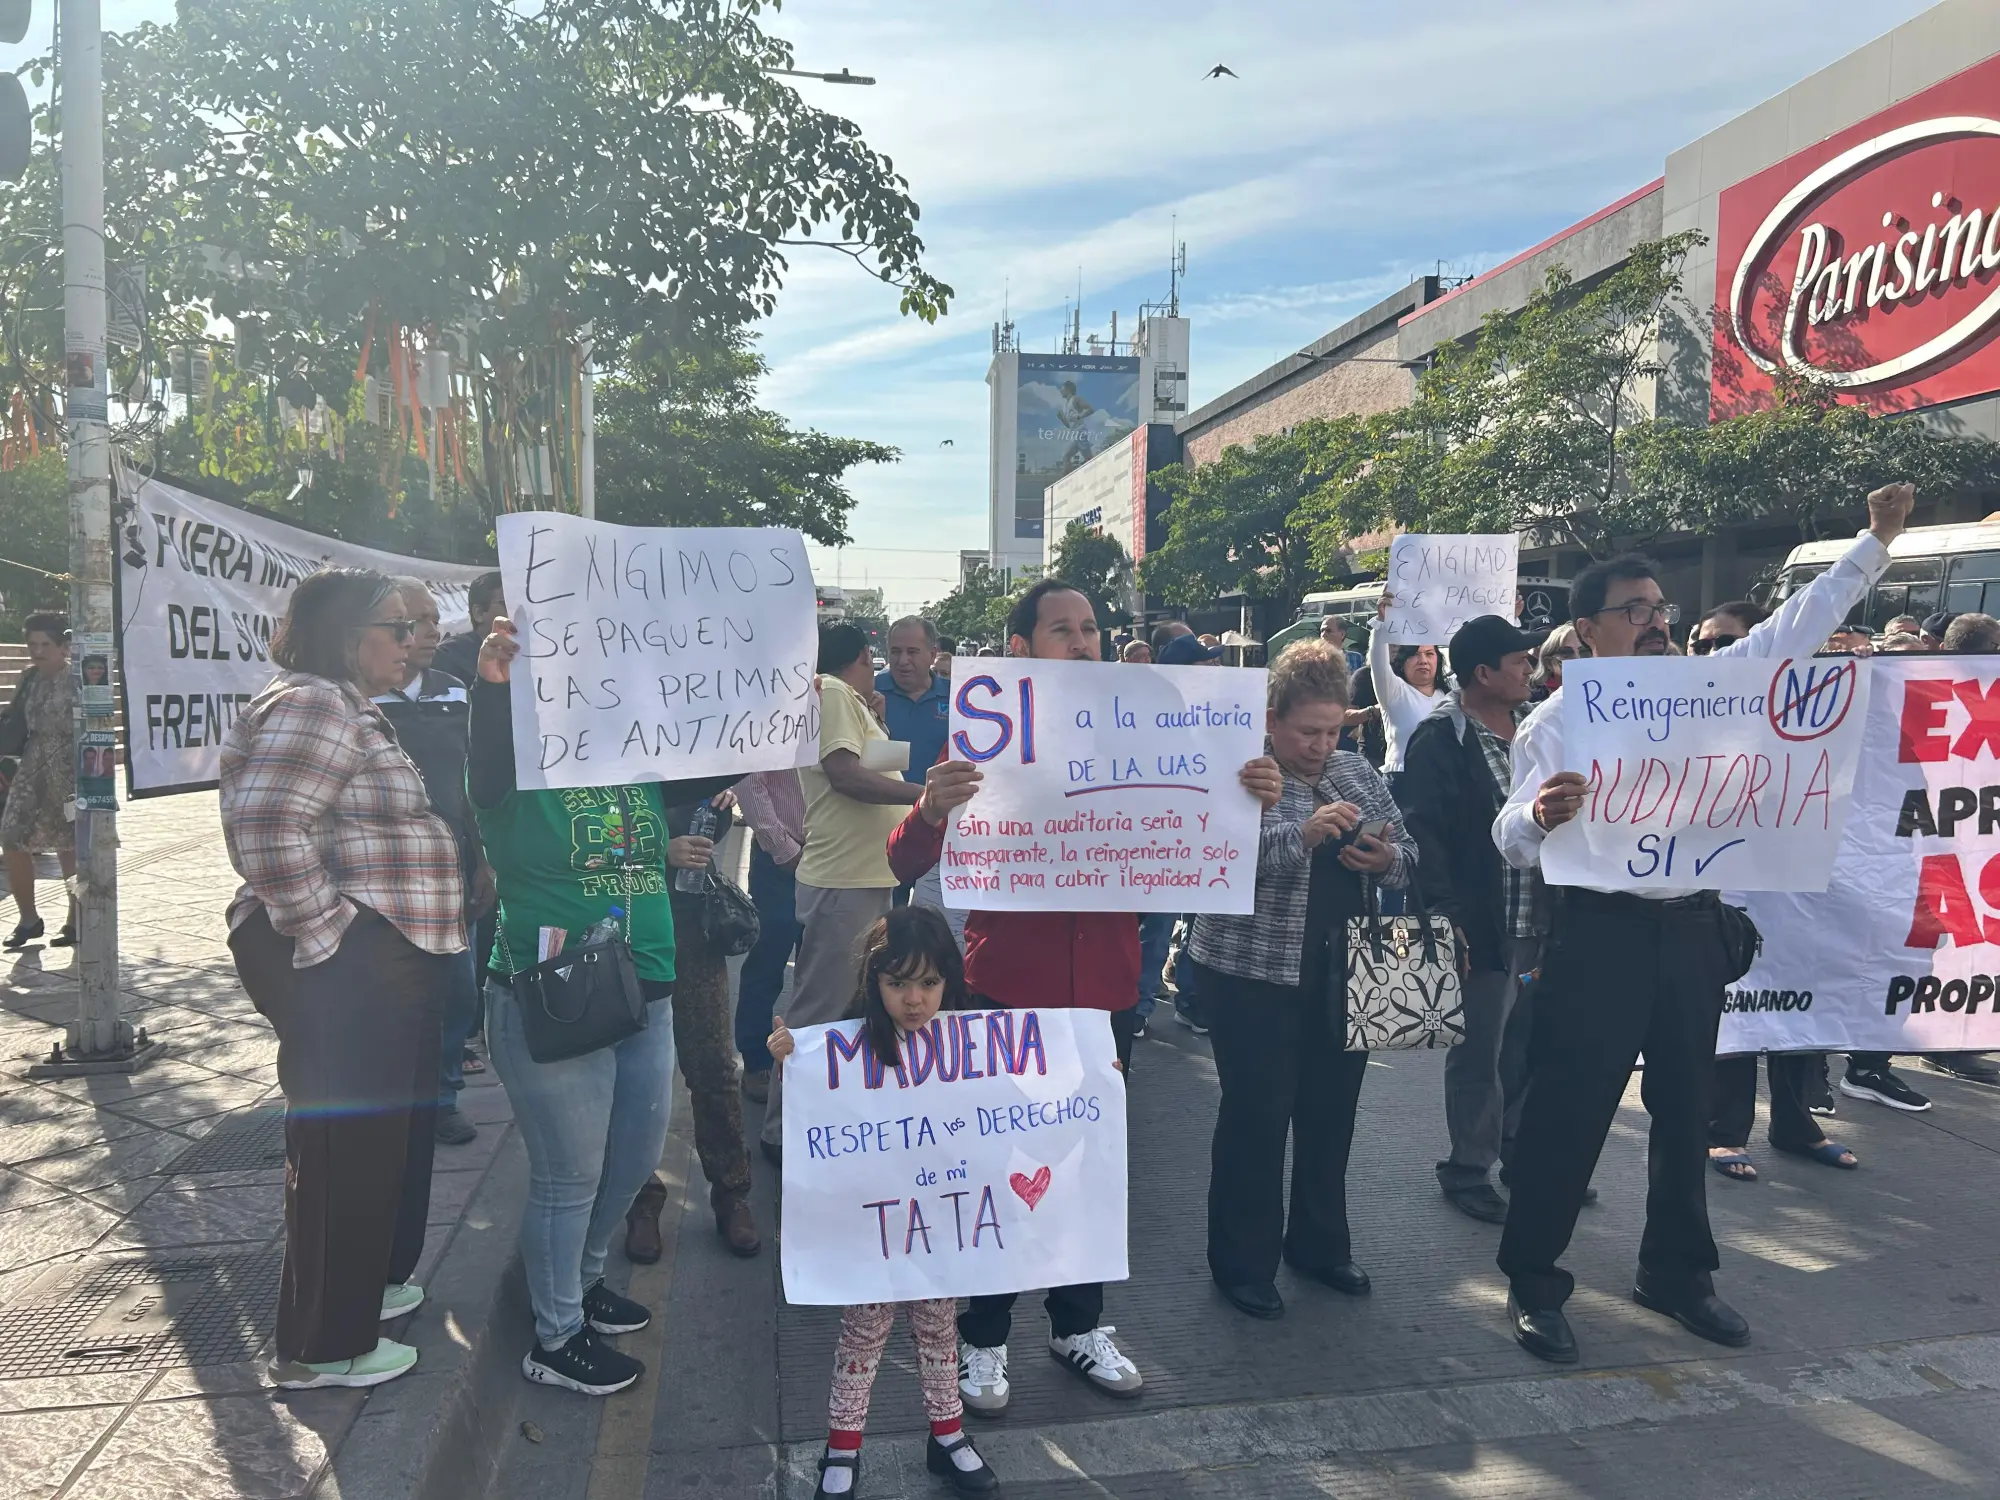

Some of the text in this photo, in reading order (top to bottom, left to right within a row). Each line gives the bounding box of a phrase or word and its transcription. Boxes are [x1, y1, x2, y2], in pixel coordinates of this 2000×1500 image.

[1038, 427, 1053, 440] te
[151, 513, 250, 583] FUERA
[525, 525, 795, 605] EXIGIMOS
[1393, 590, 1426, 609] SE
[168, 604, 230, 661] DEL
[521, 616, 754, 658] SE PAGUEN
[1388, 619, 1429, 636] LAS
[537, 662, 810, 710] LAS PRIMAS
[1781, 665, 1843, 728] NO
[537, 705, 821, 770] DE ANTIGUEDAD
[951, 674, 1252, 764] SI a la auditoria
[1068, 754, 1207, 782] DE LA UAS
[1587, 749, 1830, 830] AUDITORIA
[956, 813, 990, 837] sin
[998, 818, 1034, 836] una
[1044, 810, 1132, 836] auditoria
[1141, 809, 1183, 831] seria
[1060, 841, 1078, 863] la
[1086, 839, 1191, 870] reingenieria
[1202, 840, 1239, 861] solo
[1627, 834, 1676, 878] SI
[1010, 872, 1045, 893] para
[1055, 867, 1110, 888] cubrir
[1120, 866, 1201, 894] ilegalidad
[806, 1096, 1101, 1160] RESPETA los DERECHOS
[915, 1159, 967, 1187] de mi
[862, 1184, 1004, 1260] TATA
